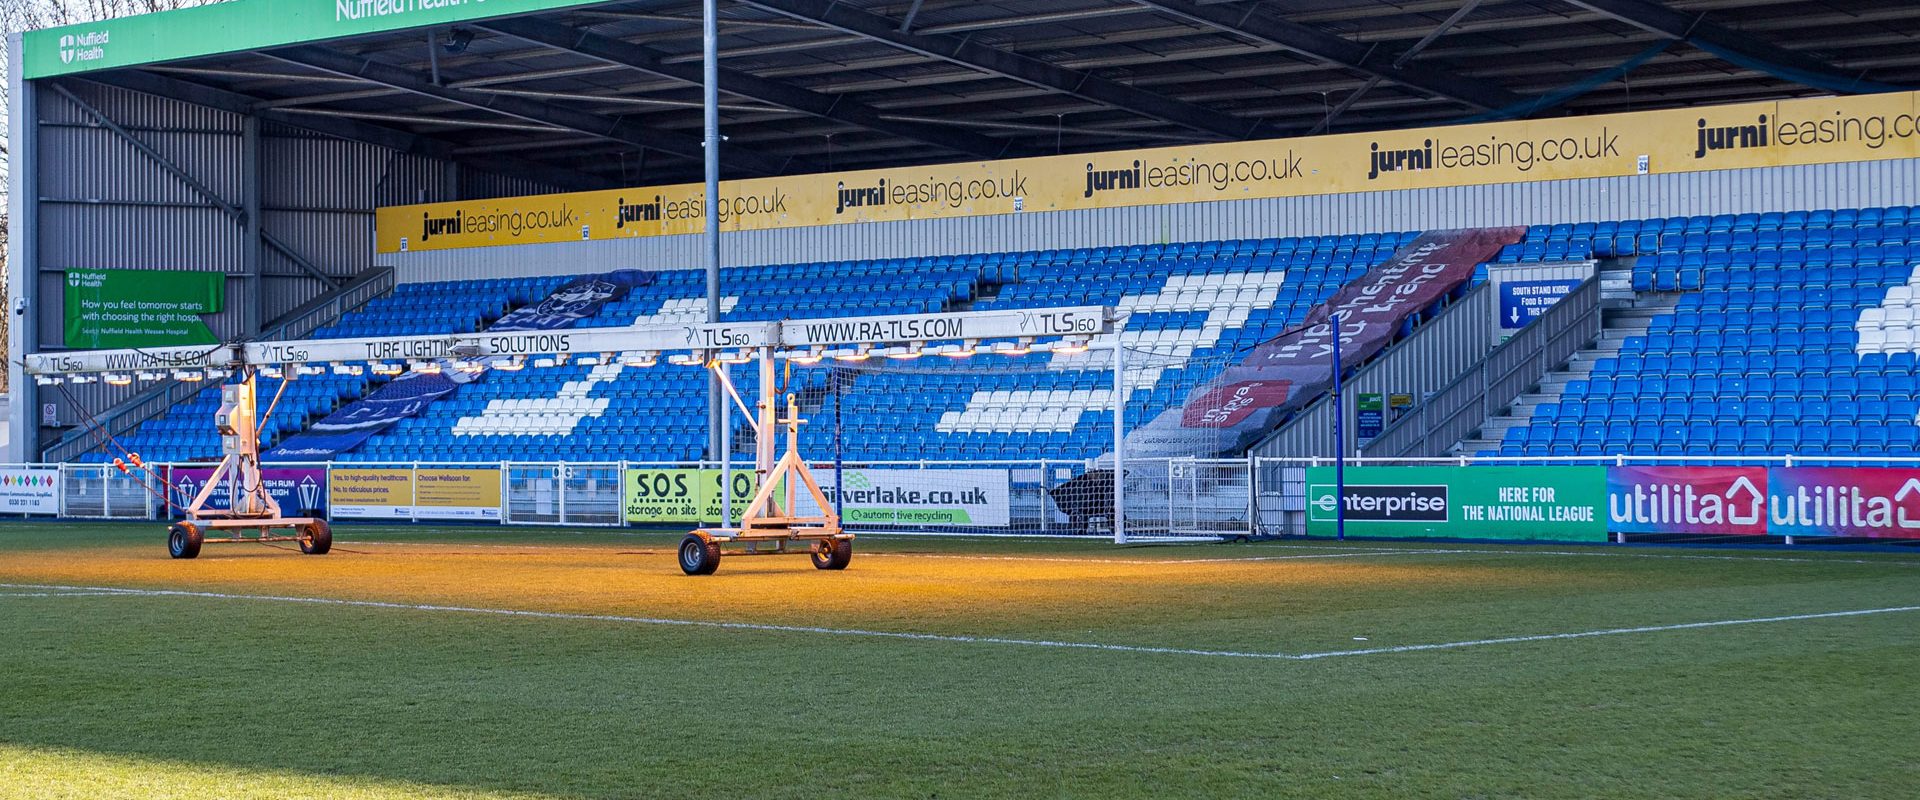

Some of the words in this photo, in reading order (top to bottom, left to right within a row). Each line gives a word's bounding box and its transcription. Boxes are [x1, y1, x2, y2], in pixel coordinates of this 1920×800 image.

[76, 30, 109, 46] Nuffield
[76, 45, 104, 61] Health
[617, 187, 787, 229] jurnileasig.co.uk
[1512, 287, 1531, 296] SOUTH
[1531, 286, 1551, 295] STAND
[1551, 285, 1570, 294] KIOSK
[81, 300, 101, 309] How
[103, 302, 119, 311] you
[120, 300, 136, 309] feel
[137, 302, 178, 310] tomorrow
[180, 302, 203, 310] starts
[1537, 297, 1542, 305] &
[82, 312, 100, 321] with
[101, 312, 139, 323] choosing
[140, 312, 155, 321] the
[156, 312, 175, 323] right
[1527, 308, 1540, 316] THIS
[805, 318, 963, 343] WWW.RA-TLS.COM
[366, 342, 399, 359] TURF
[490, 335, 570, 353] SOLUTIONS
[105, 351, 212, 370] WWW.RA-TLS.COM
[350, 474, 380, 482] high-quality
[637, 473, 688, 498] SOS
[819, 486, 988, 505] Siverlake.co.uk
[1499, 487, 1528, 503] HERE
[1532, 487, 1555, 503] FOR
[628, 505, 663, 518] storage
[667, 506, 678, 515] on
[681, 504, 697, 515] site
[1610, 483, 1723, 525] utilita
[1771, 485, 1893, 528] utilita
[862, 511, 912, 520] automotive
[914, 509, 953, 522] recycling
[1463, 505, 1484, 521] THE
[1488, 505, 1545, 521] NATIONAL
[1549, 506, 1594, 522] LEAGUE
